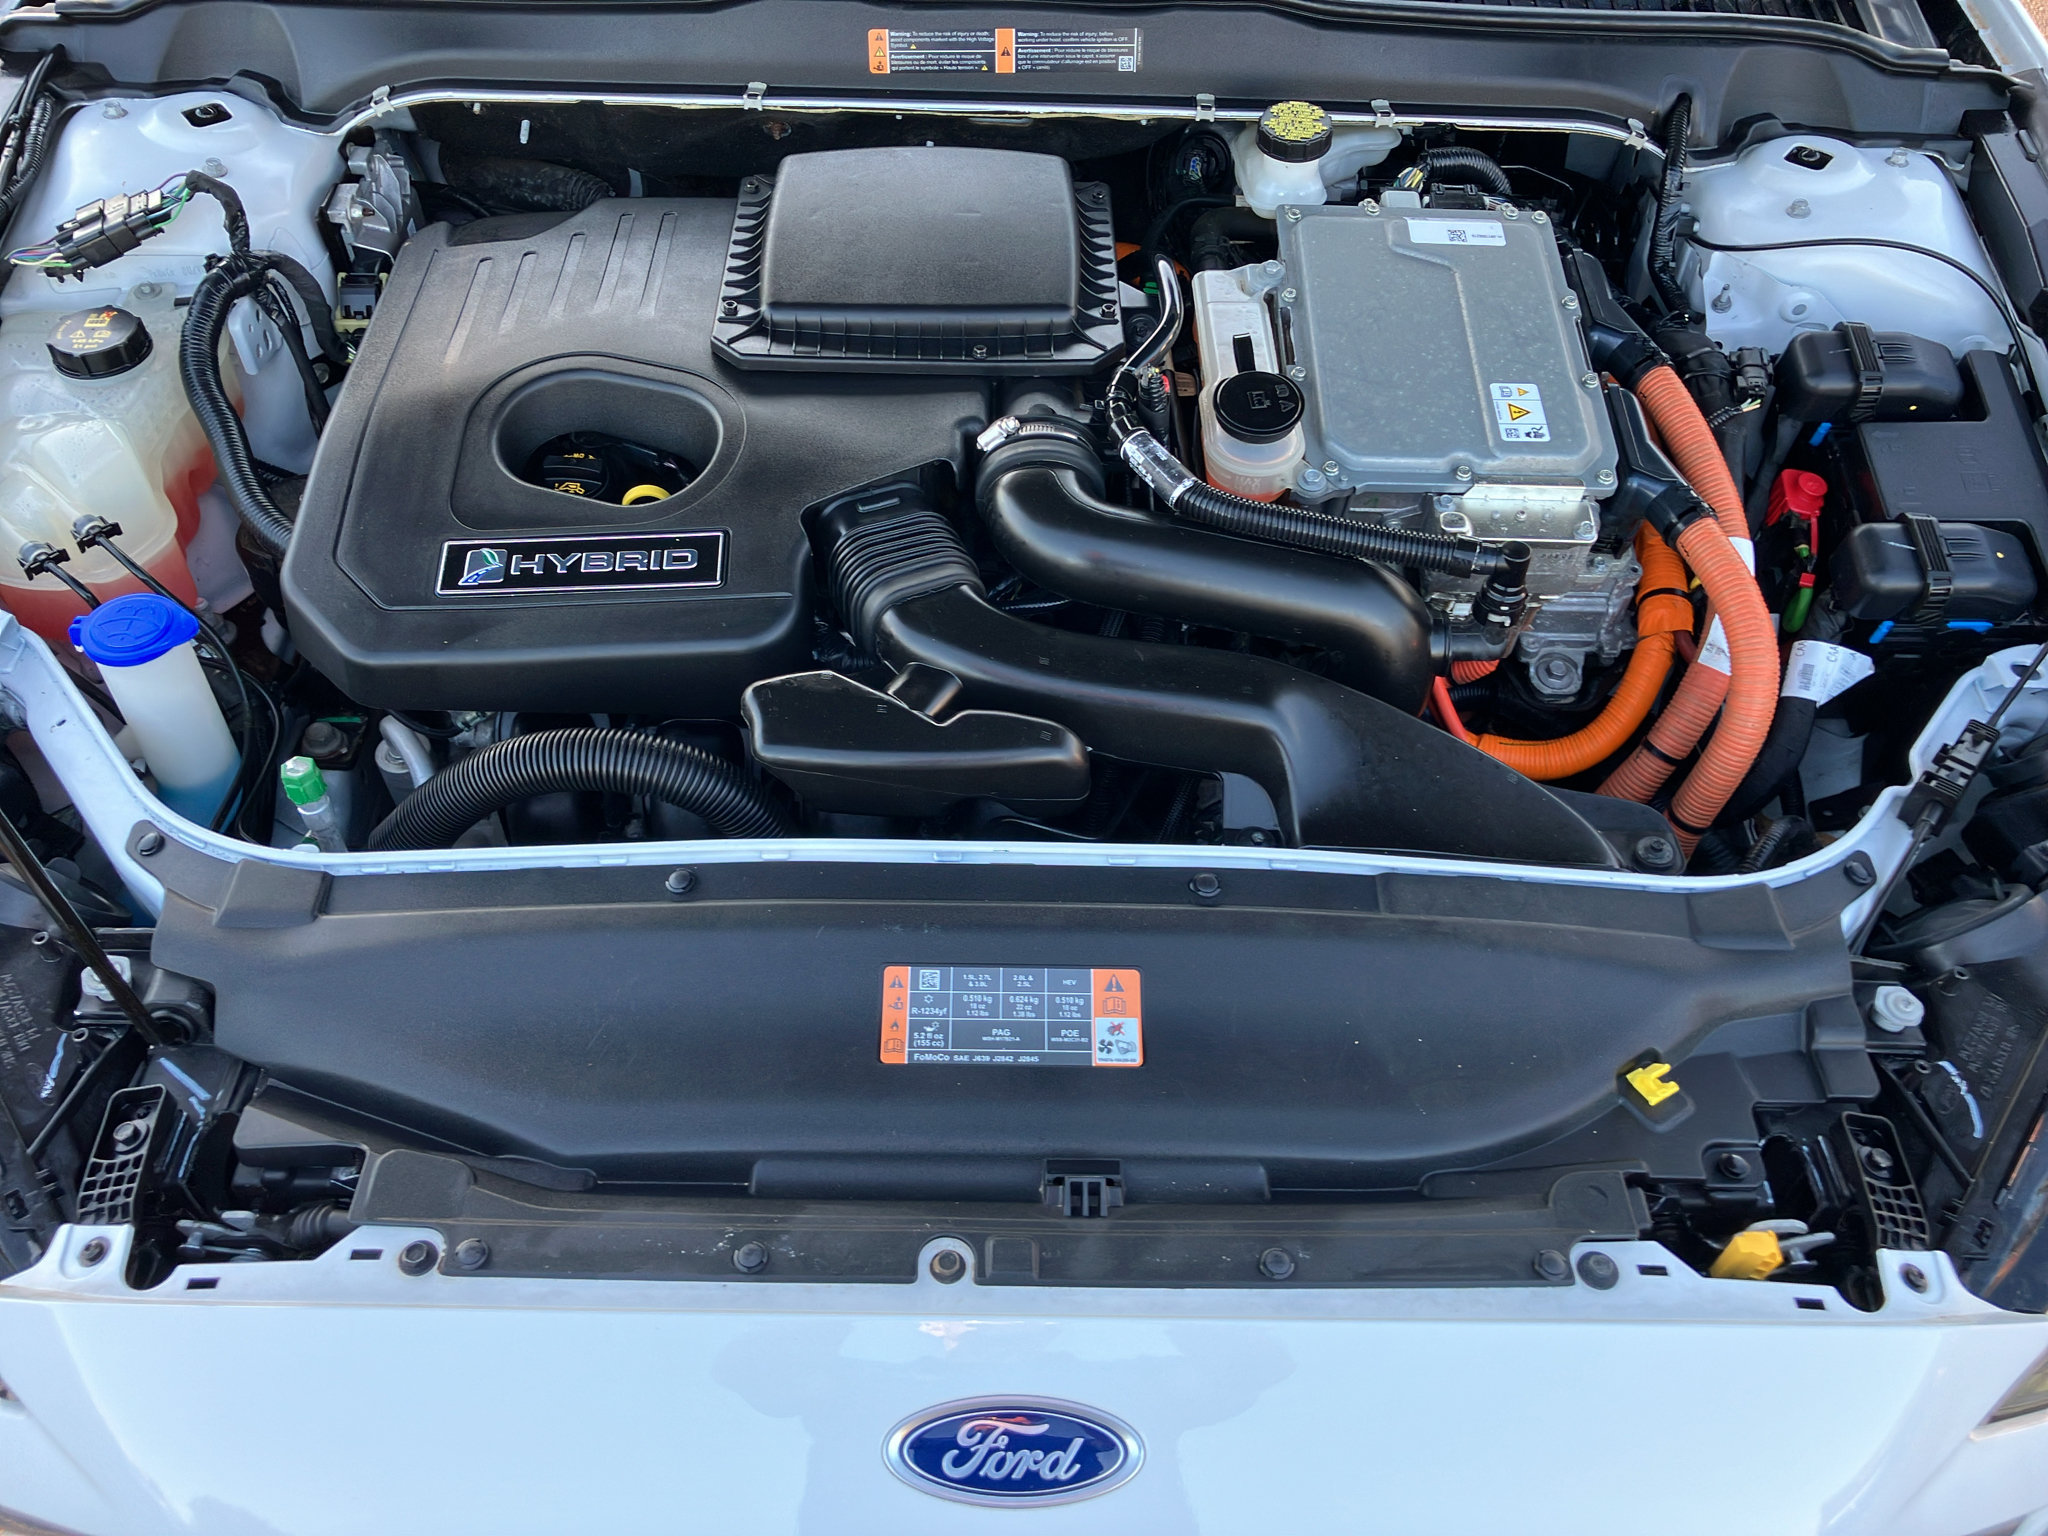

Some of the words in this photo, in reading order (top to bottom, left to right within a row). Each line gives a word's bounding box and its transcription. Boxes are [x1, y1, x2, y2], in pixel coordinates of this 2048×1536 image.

[511, 549, 698, 575] HYBRID
[983, 994, 992, 1004] kg
[1029, 995, 1039, 1005] kg
[1075, 996, 1084, 1006] kg
[911, 1007, 947, 1016] R-1234yf
[913, 1032, 925, 1040] 5.2
[1061, 1029, 1079, 1037] POE
[913, 1040, 930, 1048] (155
[932, 1040, 945, 1048] cc)
[913, 1053, 950, 1061] FoMoCo
[953, 1054, 970, 1062] SAE
[941, 1419, 1085, 1481] Ford
